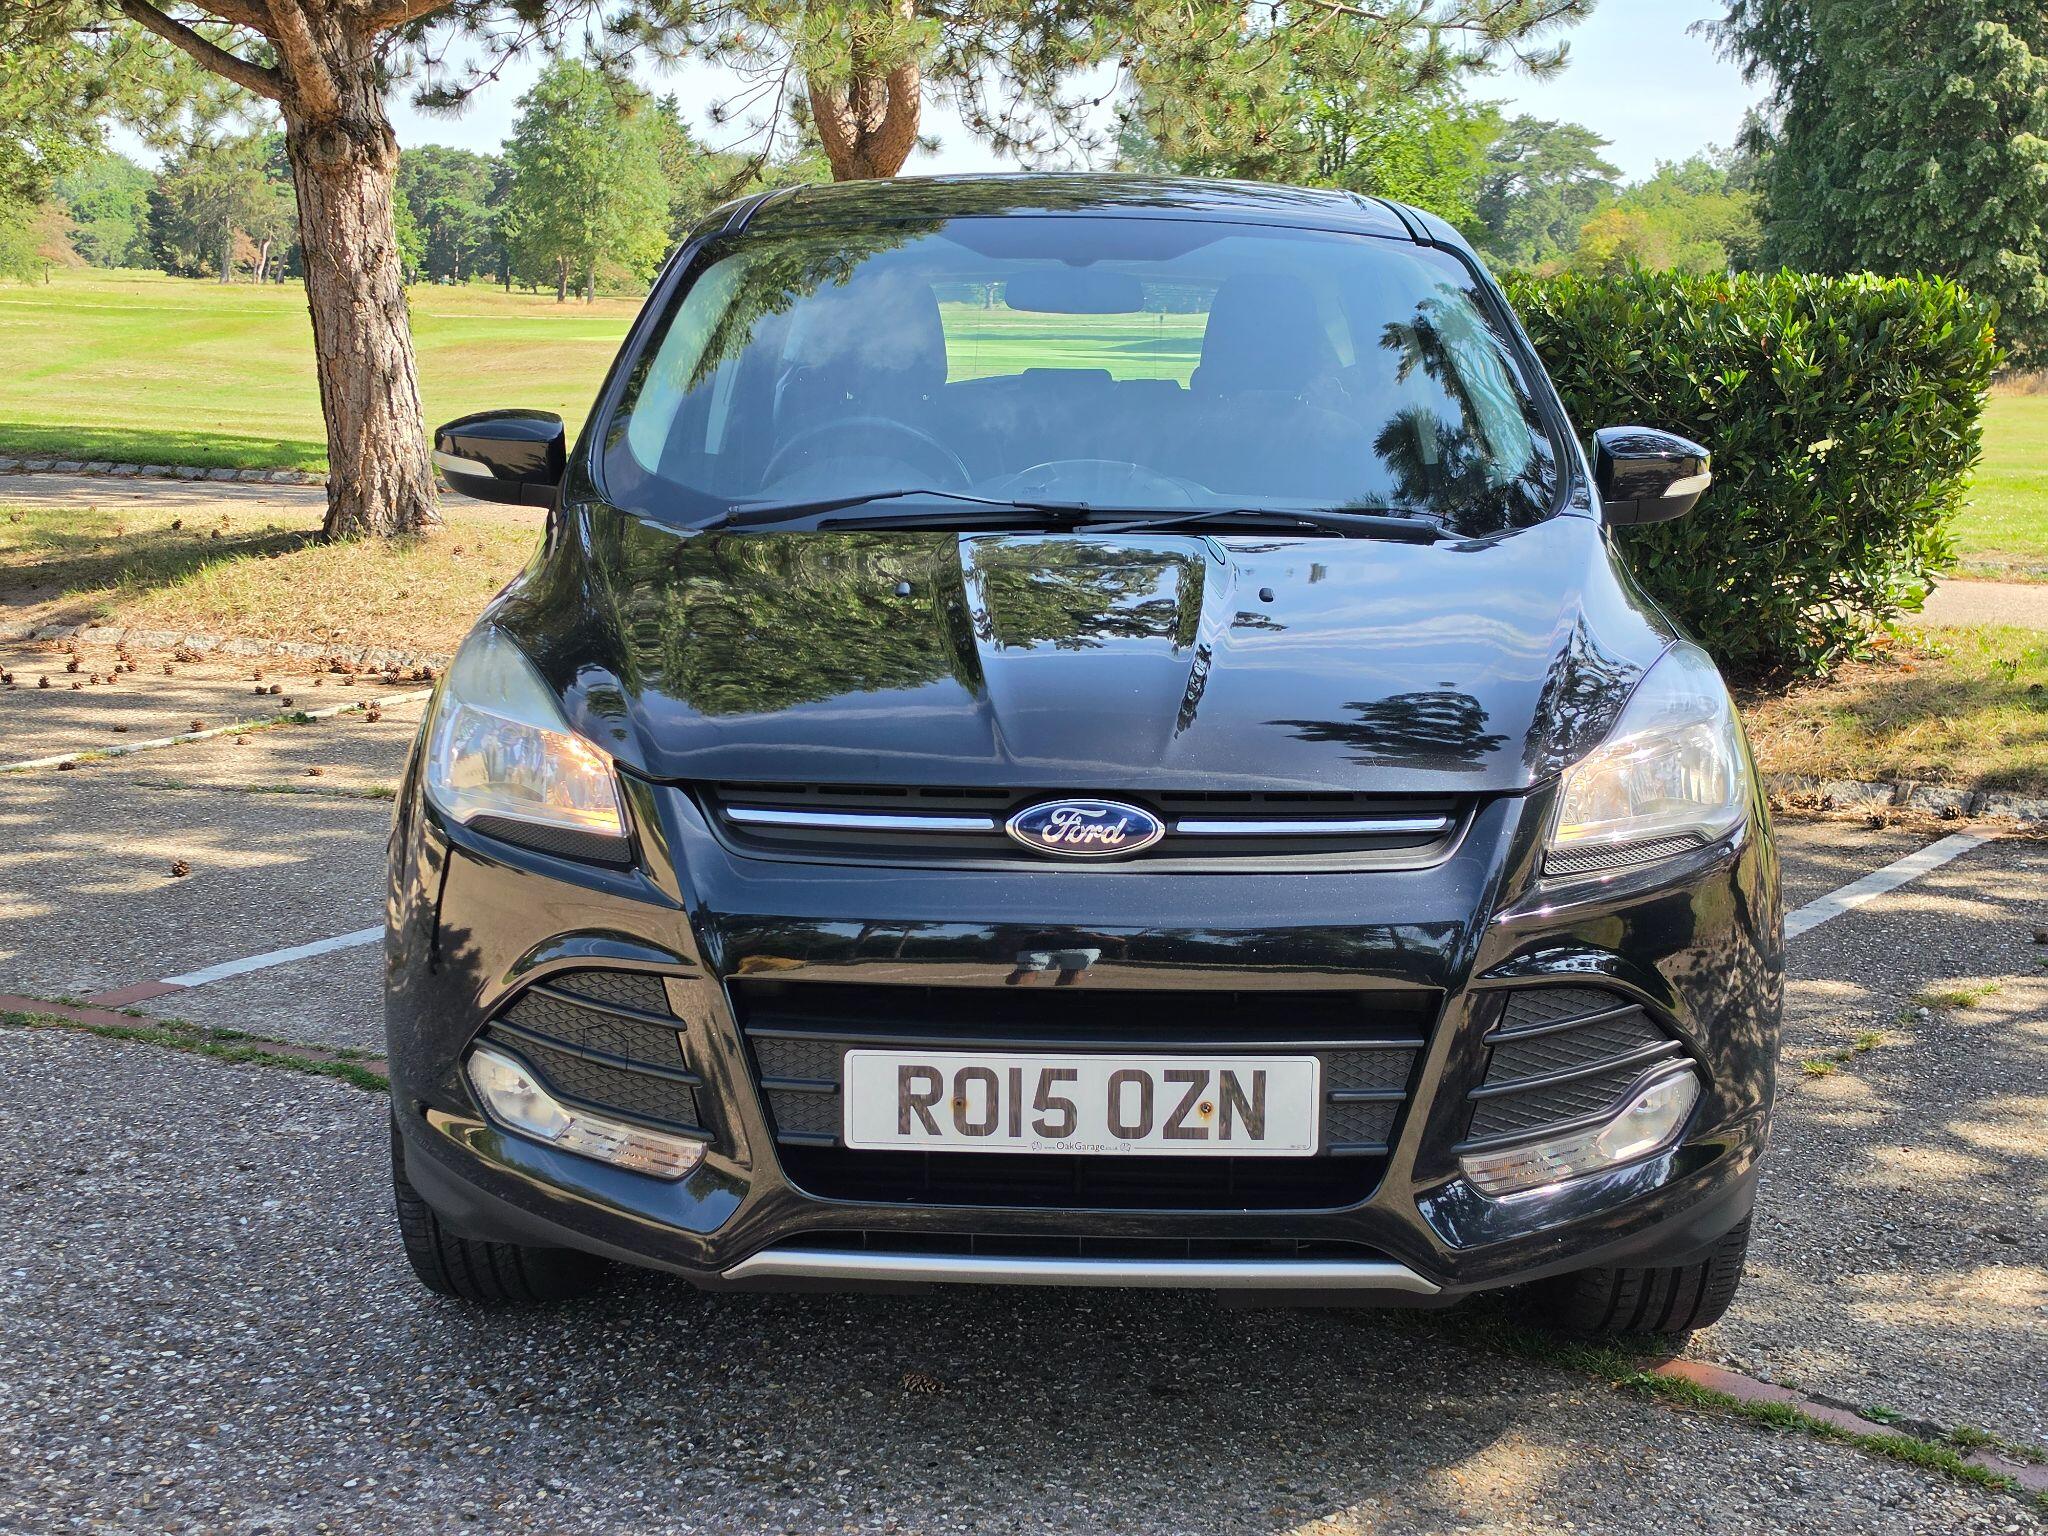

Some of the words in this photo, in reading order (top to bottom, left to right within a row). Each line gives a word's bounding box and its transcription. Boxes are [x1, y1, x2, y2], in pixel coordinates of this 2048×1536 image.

[1041, 807, 1128, 844] Ford
[897, 1064, 1078, 1139] RO15
[1107, 1069, 1267, 1141] OZN
